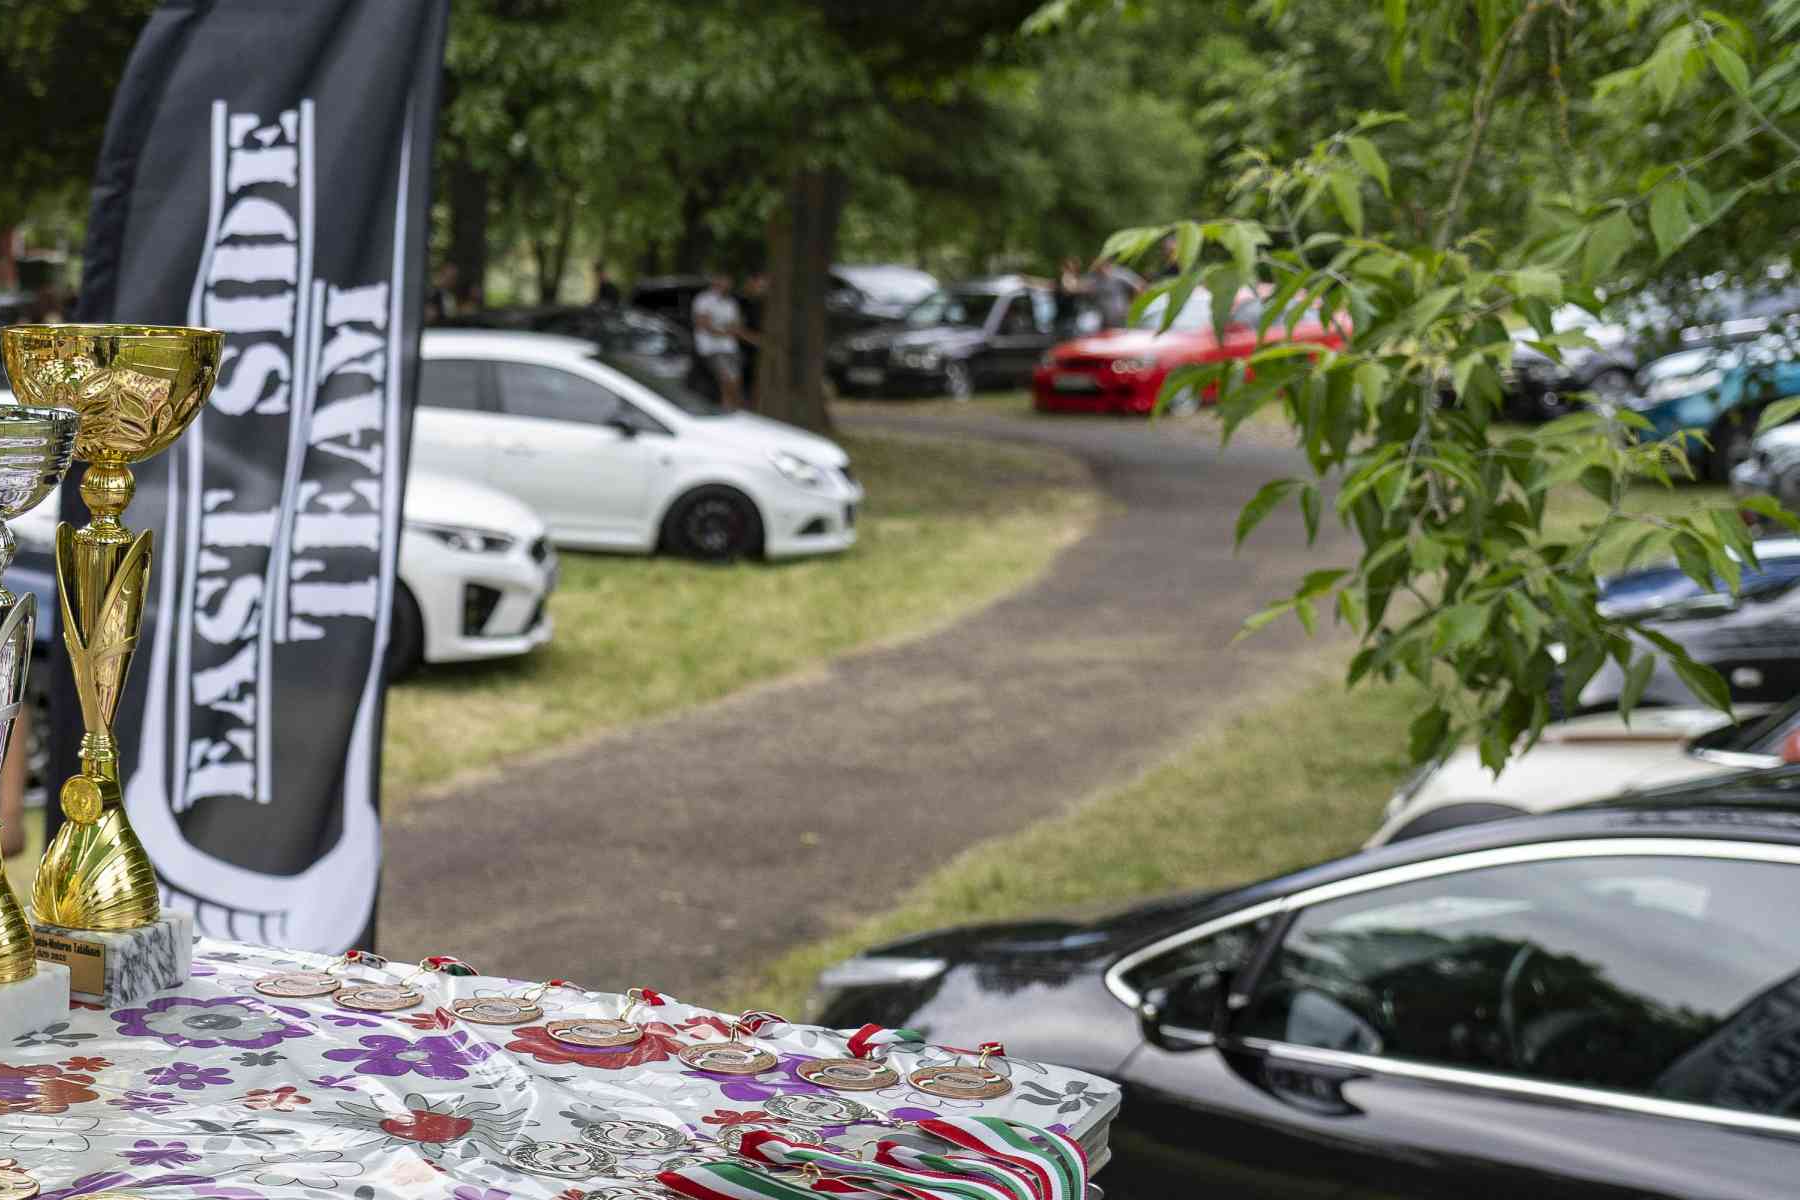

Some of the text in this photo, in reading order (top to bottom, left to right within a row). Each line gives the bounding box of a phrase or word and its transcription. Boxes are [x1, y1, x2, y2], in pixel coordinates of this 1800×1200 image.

[185, 110, 299, 808] EAST SIDE
[288, 280, 389, 642] TEAM
